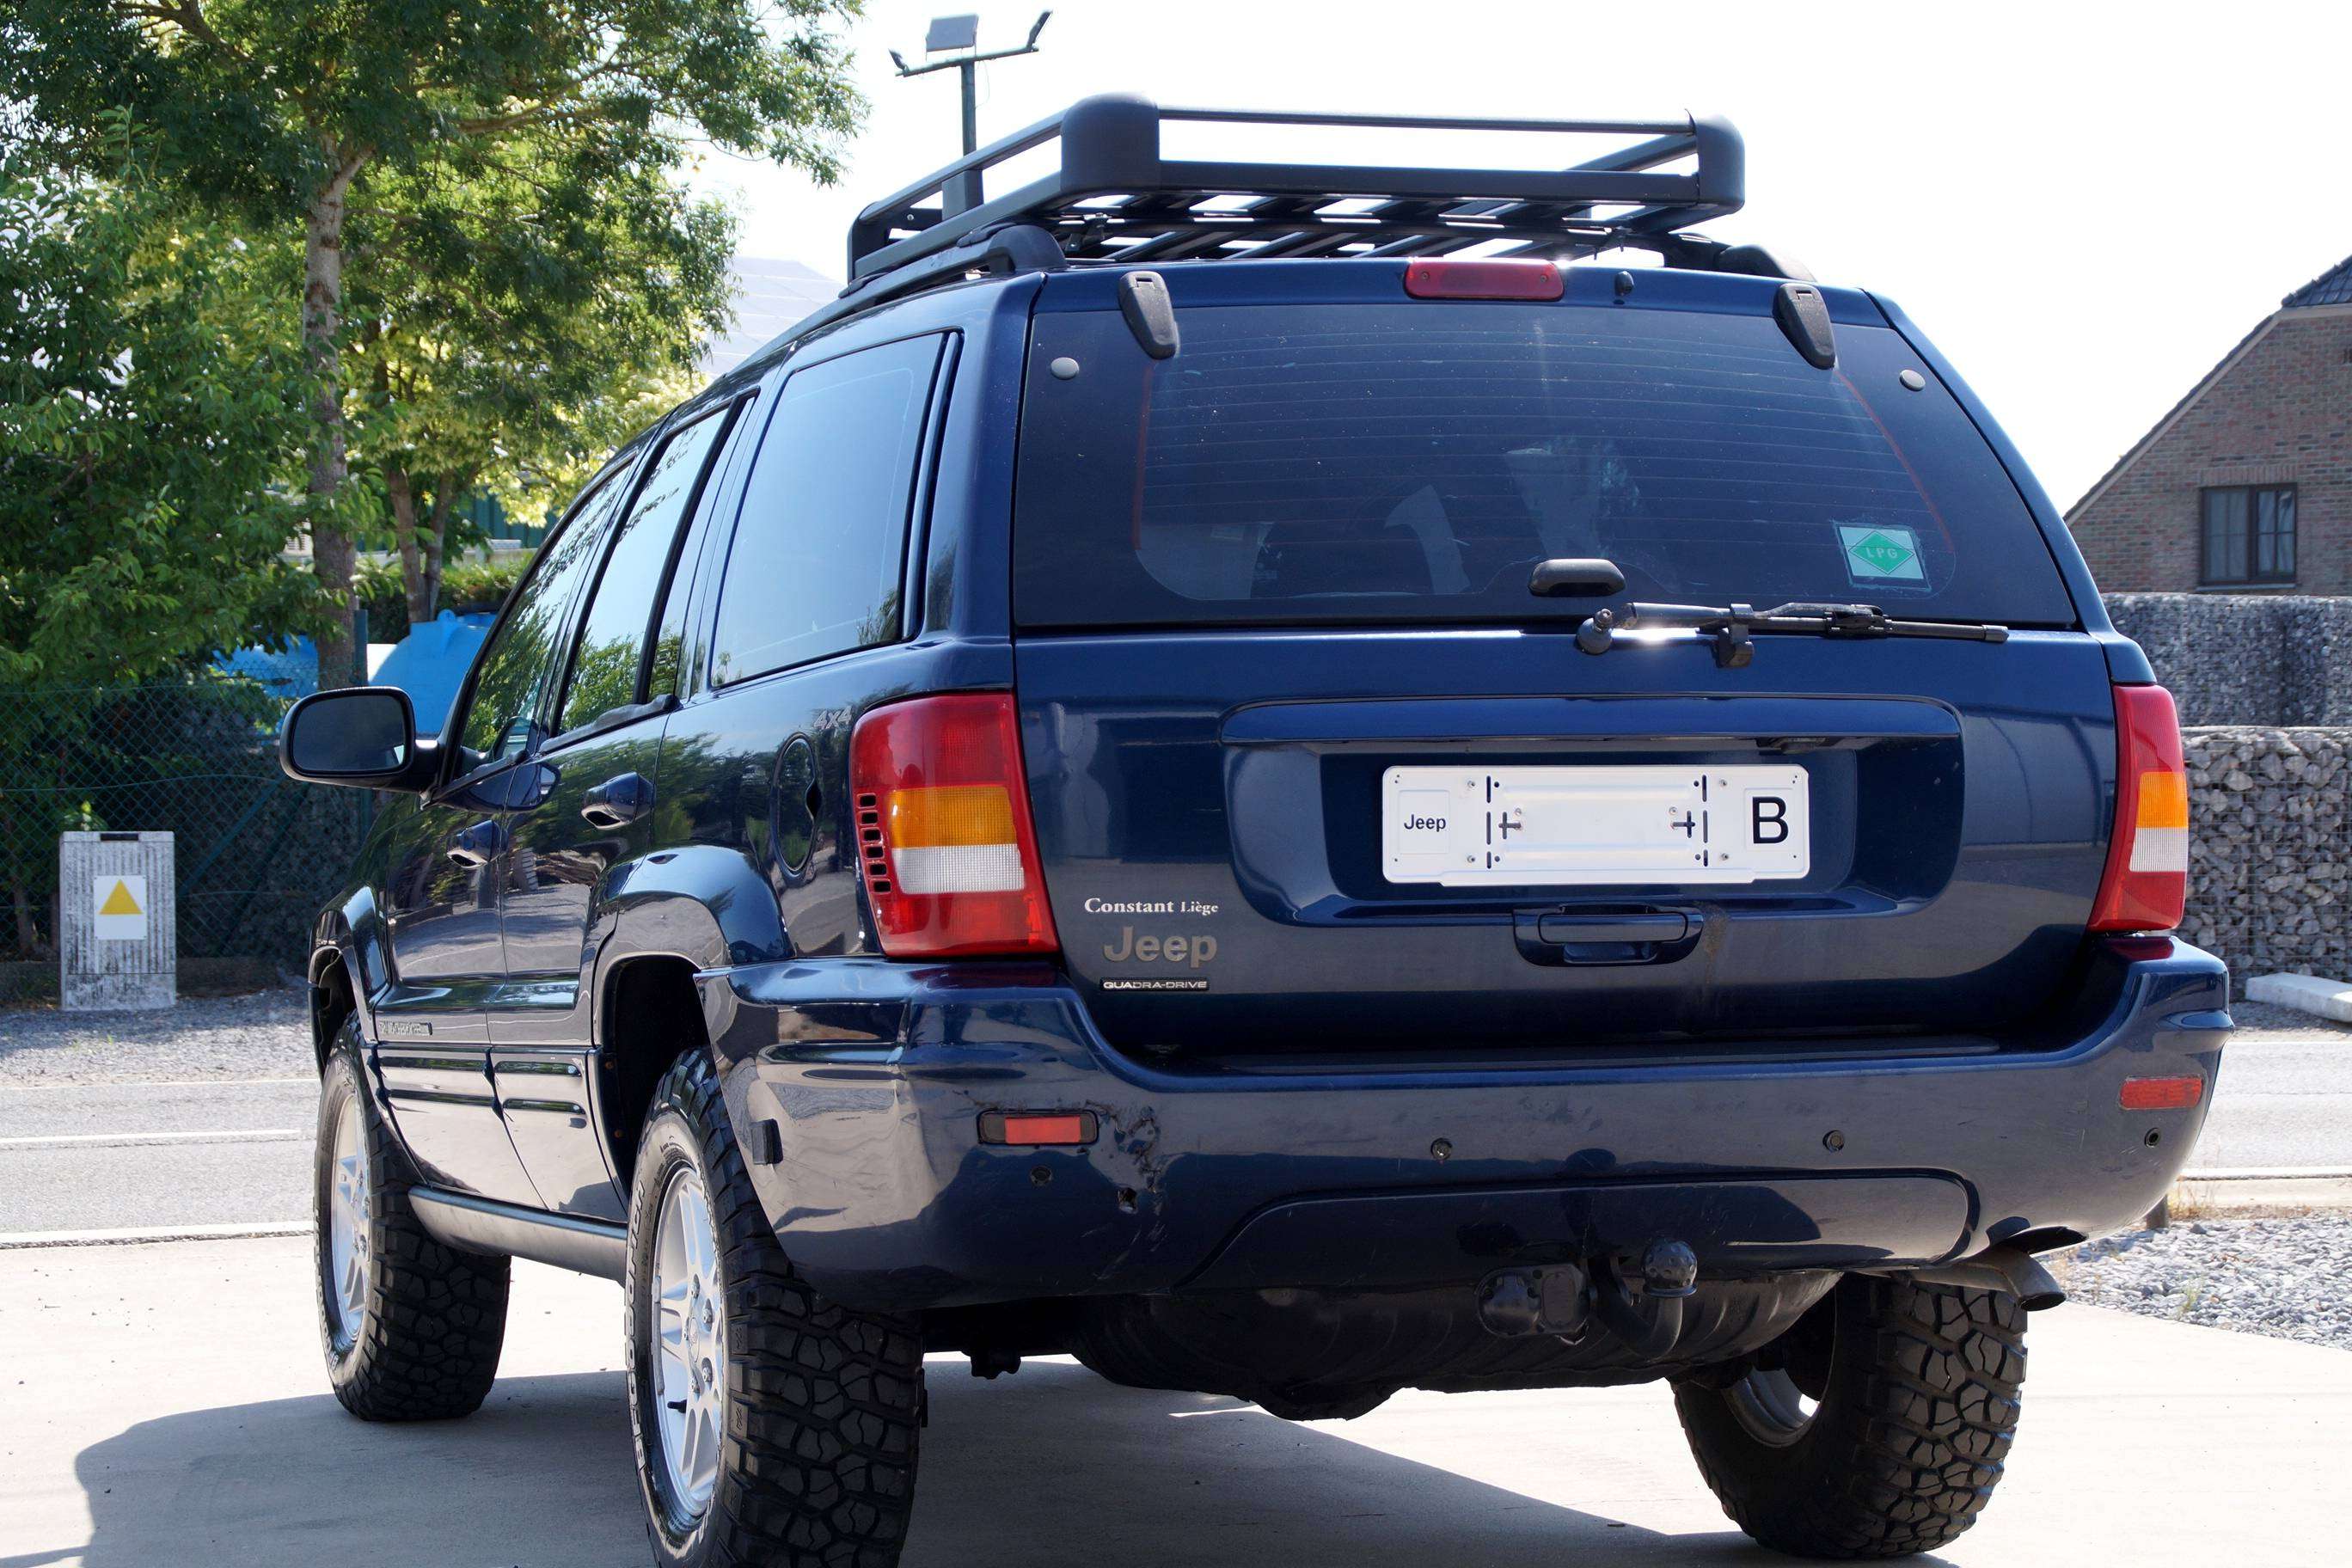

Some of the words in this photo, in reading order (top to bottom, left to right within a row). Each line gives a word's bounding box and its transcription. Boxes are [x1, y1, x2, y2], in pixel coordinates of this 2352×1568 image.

[1865, 546, 1898, 559] LPG
[813, 705, 852, 730] 4x4
[1404, 813, 1446, 832] Jeep
[1752, 796, 1789, 844] B
[1084, 897, 1173, 913] Constant
[1180, 901, 1219, 916] Liège
[1104, 925, 1217, 968] Jeep
[1103, 980, 1208, 989] QUADRA-DRIVE
